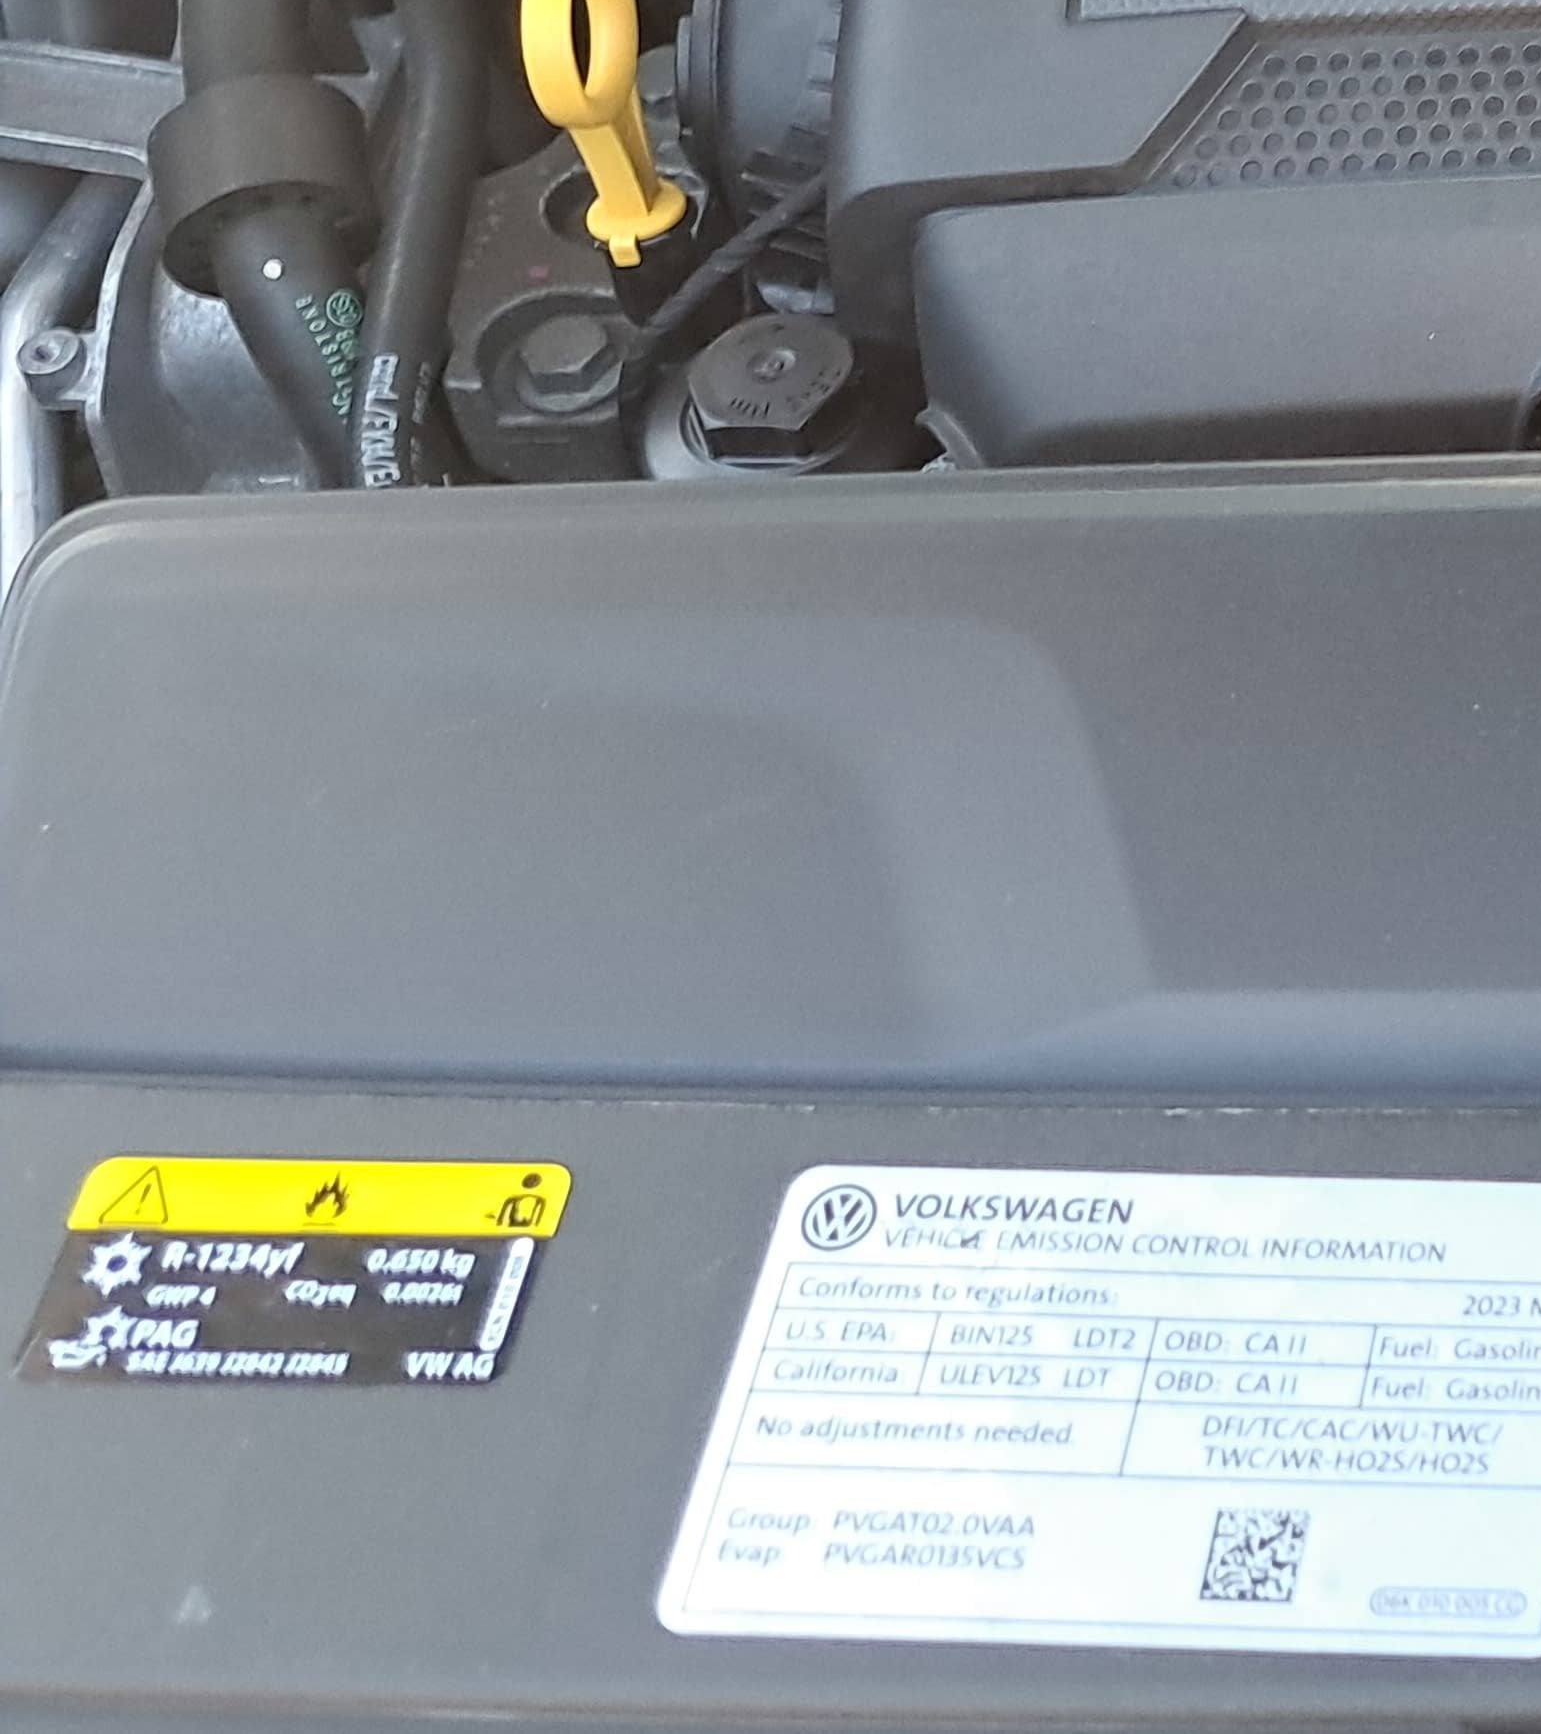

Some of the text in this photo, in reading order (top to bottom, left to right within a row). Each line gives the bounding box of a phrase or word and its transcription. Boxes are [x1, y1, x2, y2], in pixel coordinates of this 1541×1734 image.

[893, 1192, 1136, 1226] VOLKSWAGEN
[996, 1228, 1126, 1255] EMISSION
[1131, 1234, 1251, 1259] CONTROL
[1259, 1236, 1448, 1264] INFORMATION
[441, 1248, 476, 1279] kg
[145, 1284, 200, 1308] GWP
[798, 1275, 923, 1303] Conforms
[931, 1280, 956, 1302] to
[1462, 1295, 1521, 1318] 2023
[130, 1318, 200, 1349] PAG
[949, 1324, 1036, 1348] BIN125
[1073, 1326, 1137, 1351] LDT2
[1244, 1332, 1283, 1356] CA
[406, 1351, 455, 1380] VW
[451, 1351, 496, 1381] AG
[939, 1364, 1042, 1389] ULEV125
[1062, 1366, 1111, 1390] LDT
[1235, 1372, 1272, 1396] CA
[755, 1415, 792, 1437] No
[800, 1415, 966, 1444] adjustments
